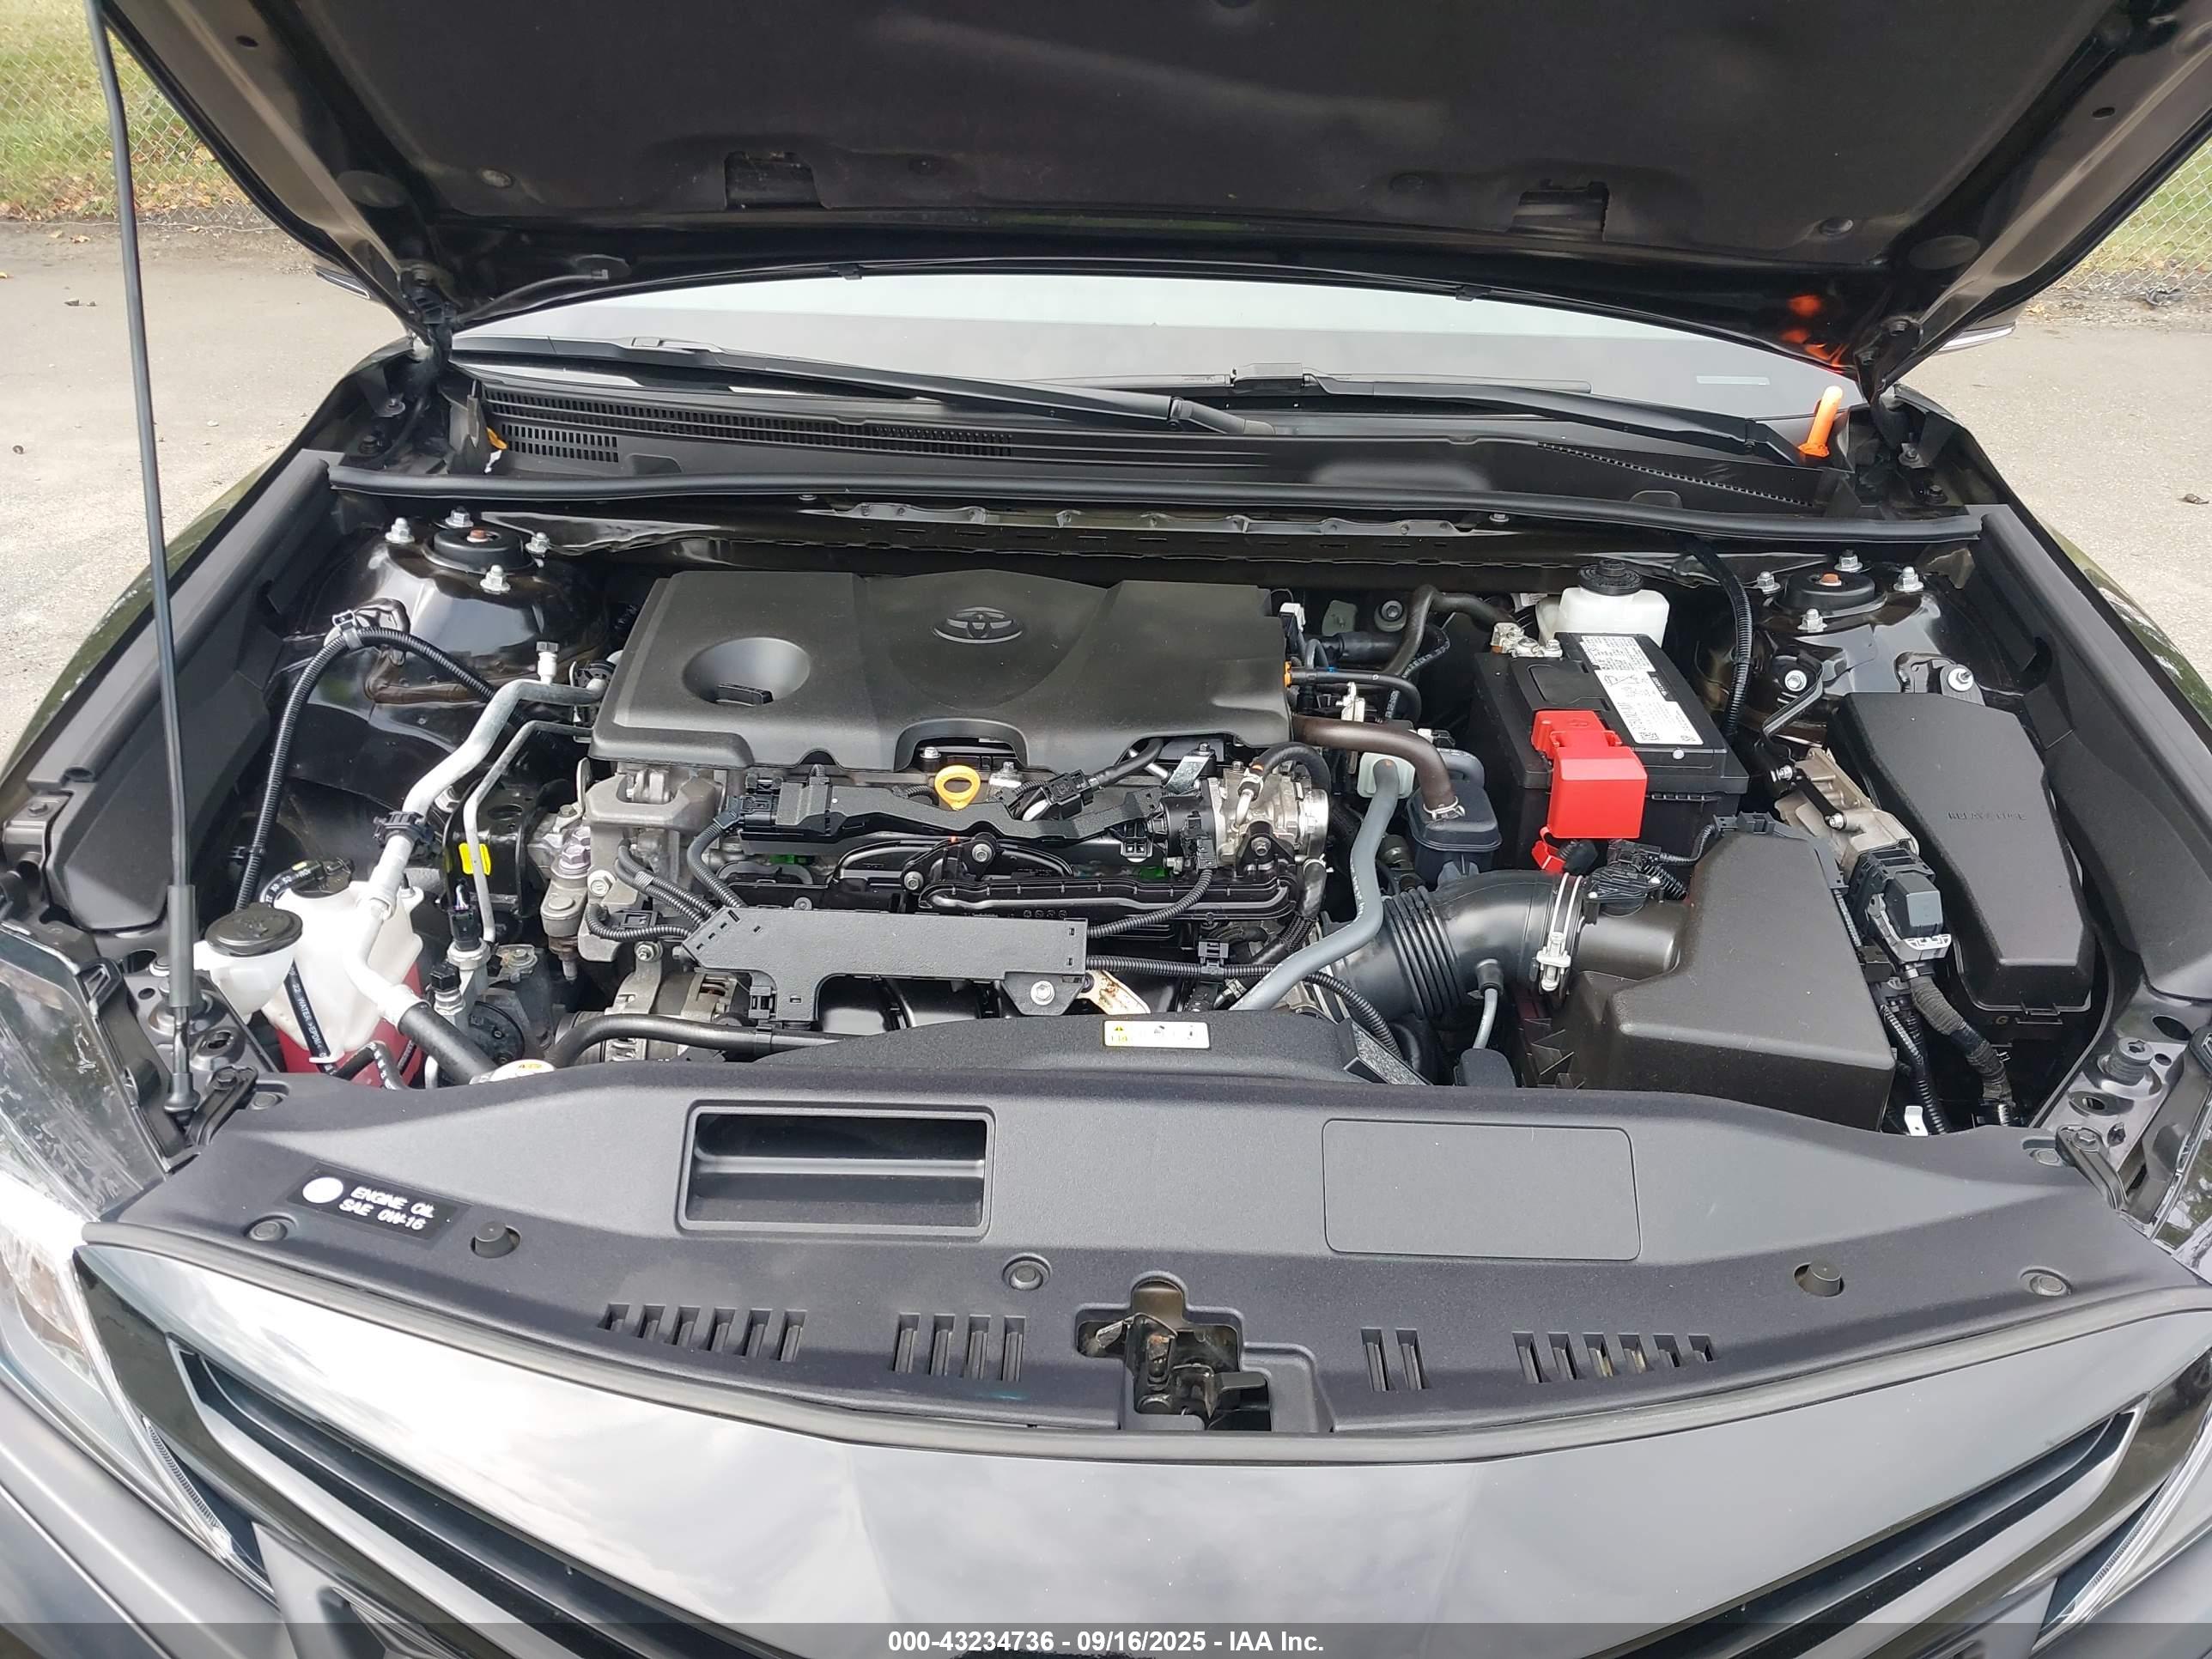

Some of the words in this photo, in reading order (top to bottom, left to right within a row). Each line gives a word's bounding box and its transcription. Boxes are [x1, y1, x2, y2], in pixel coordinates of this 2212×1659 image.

[297, 997, 312, 1021] WATER
[350, 1186, 408, 1210] ENGINE
[339, 1199, 374, 1217] SAE
[377, 1208, 426, 1231] 0W-16
